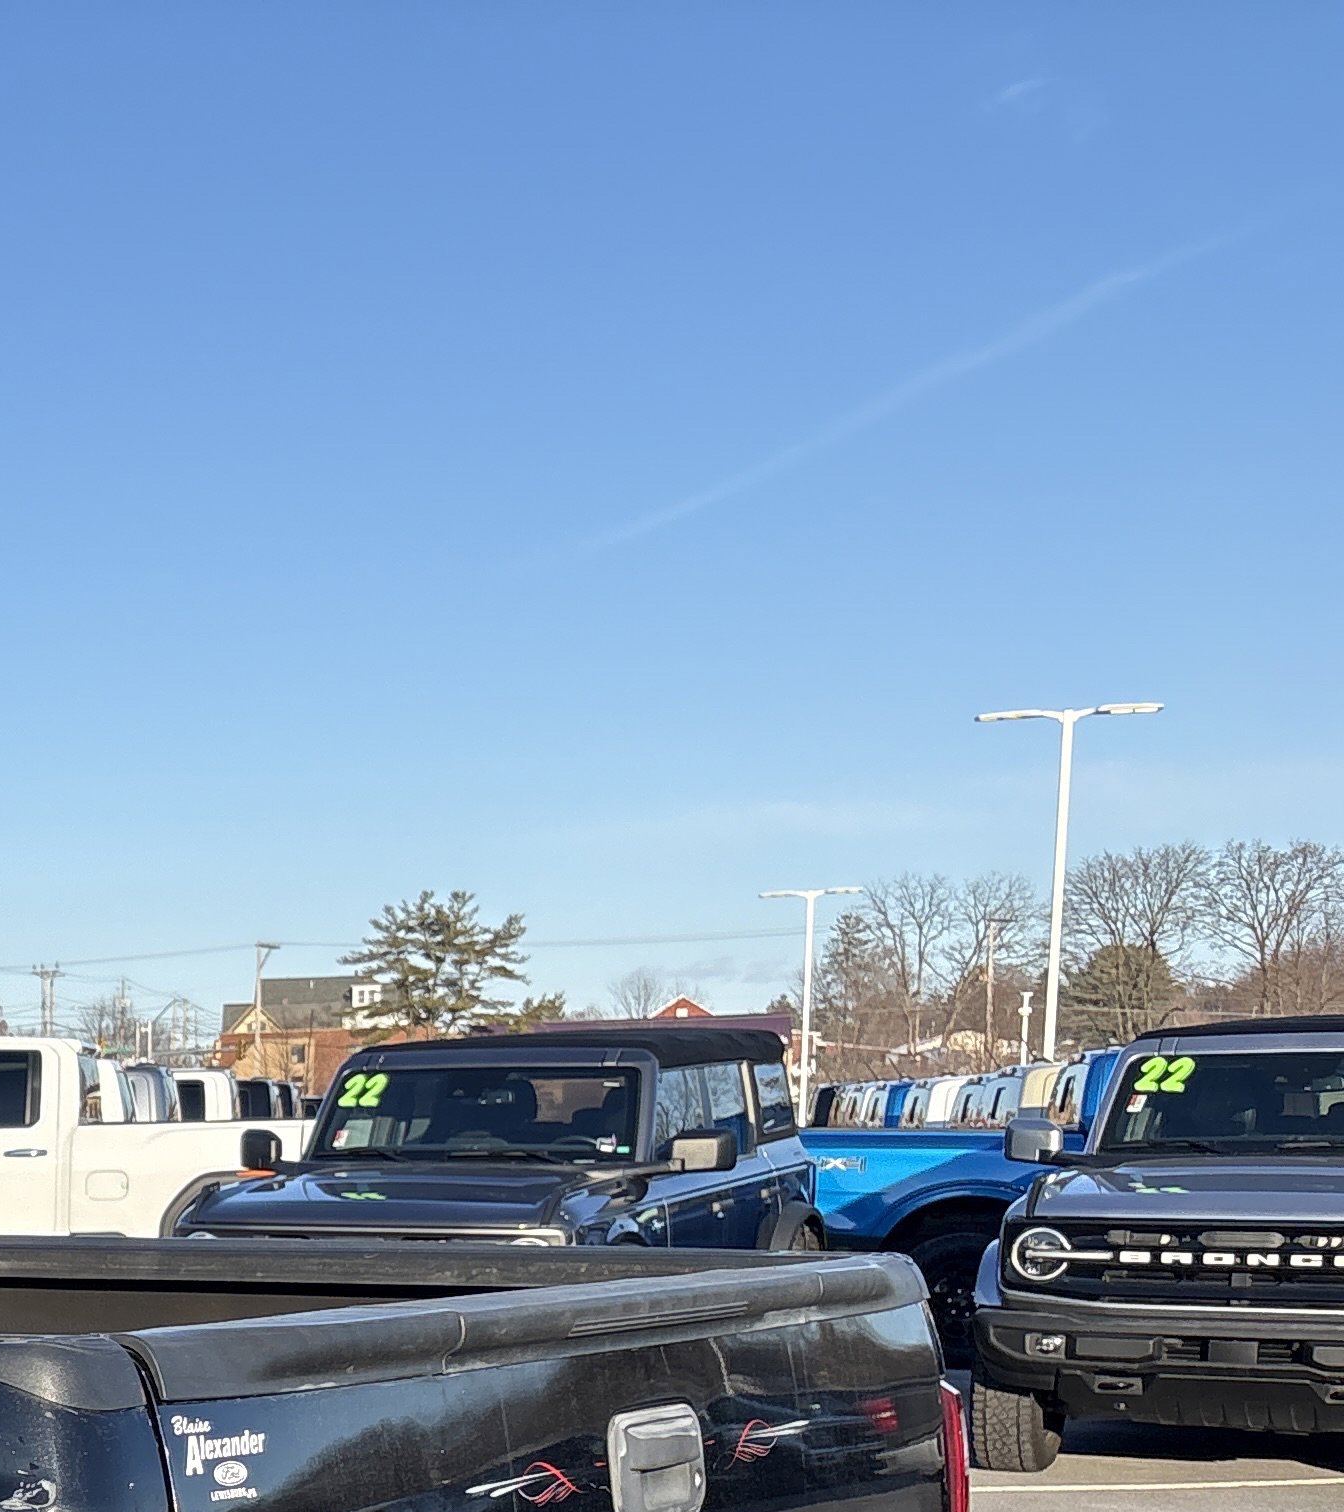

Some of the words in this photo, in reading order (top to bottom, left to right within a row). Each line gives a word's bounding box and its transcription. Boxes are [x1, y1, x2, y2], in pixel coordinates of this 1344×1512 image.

[338, 1073, 388, 1107] 22
[1134, 1056, 1196, 1092] 22
[171, 1416, 211, 1435] Blaise
[186, 1430, 265, 1476] Alexander
